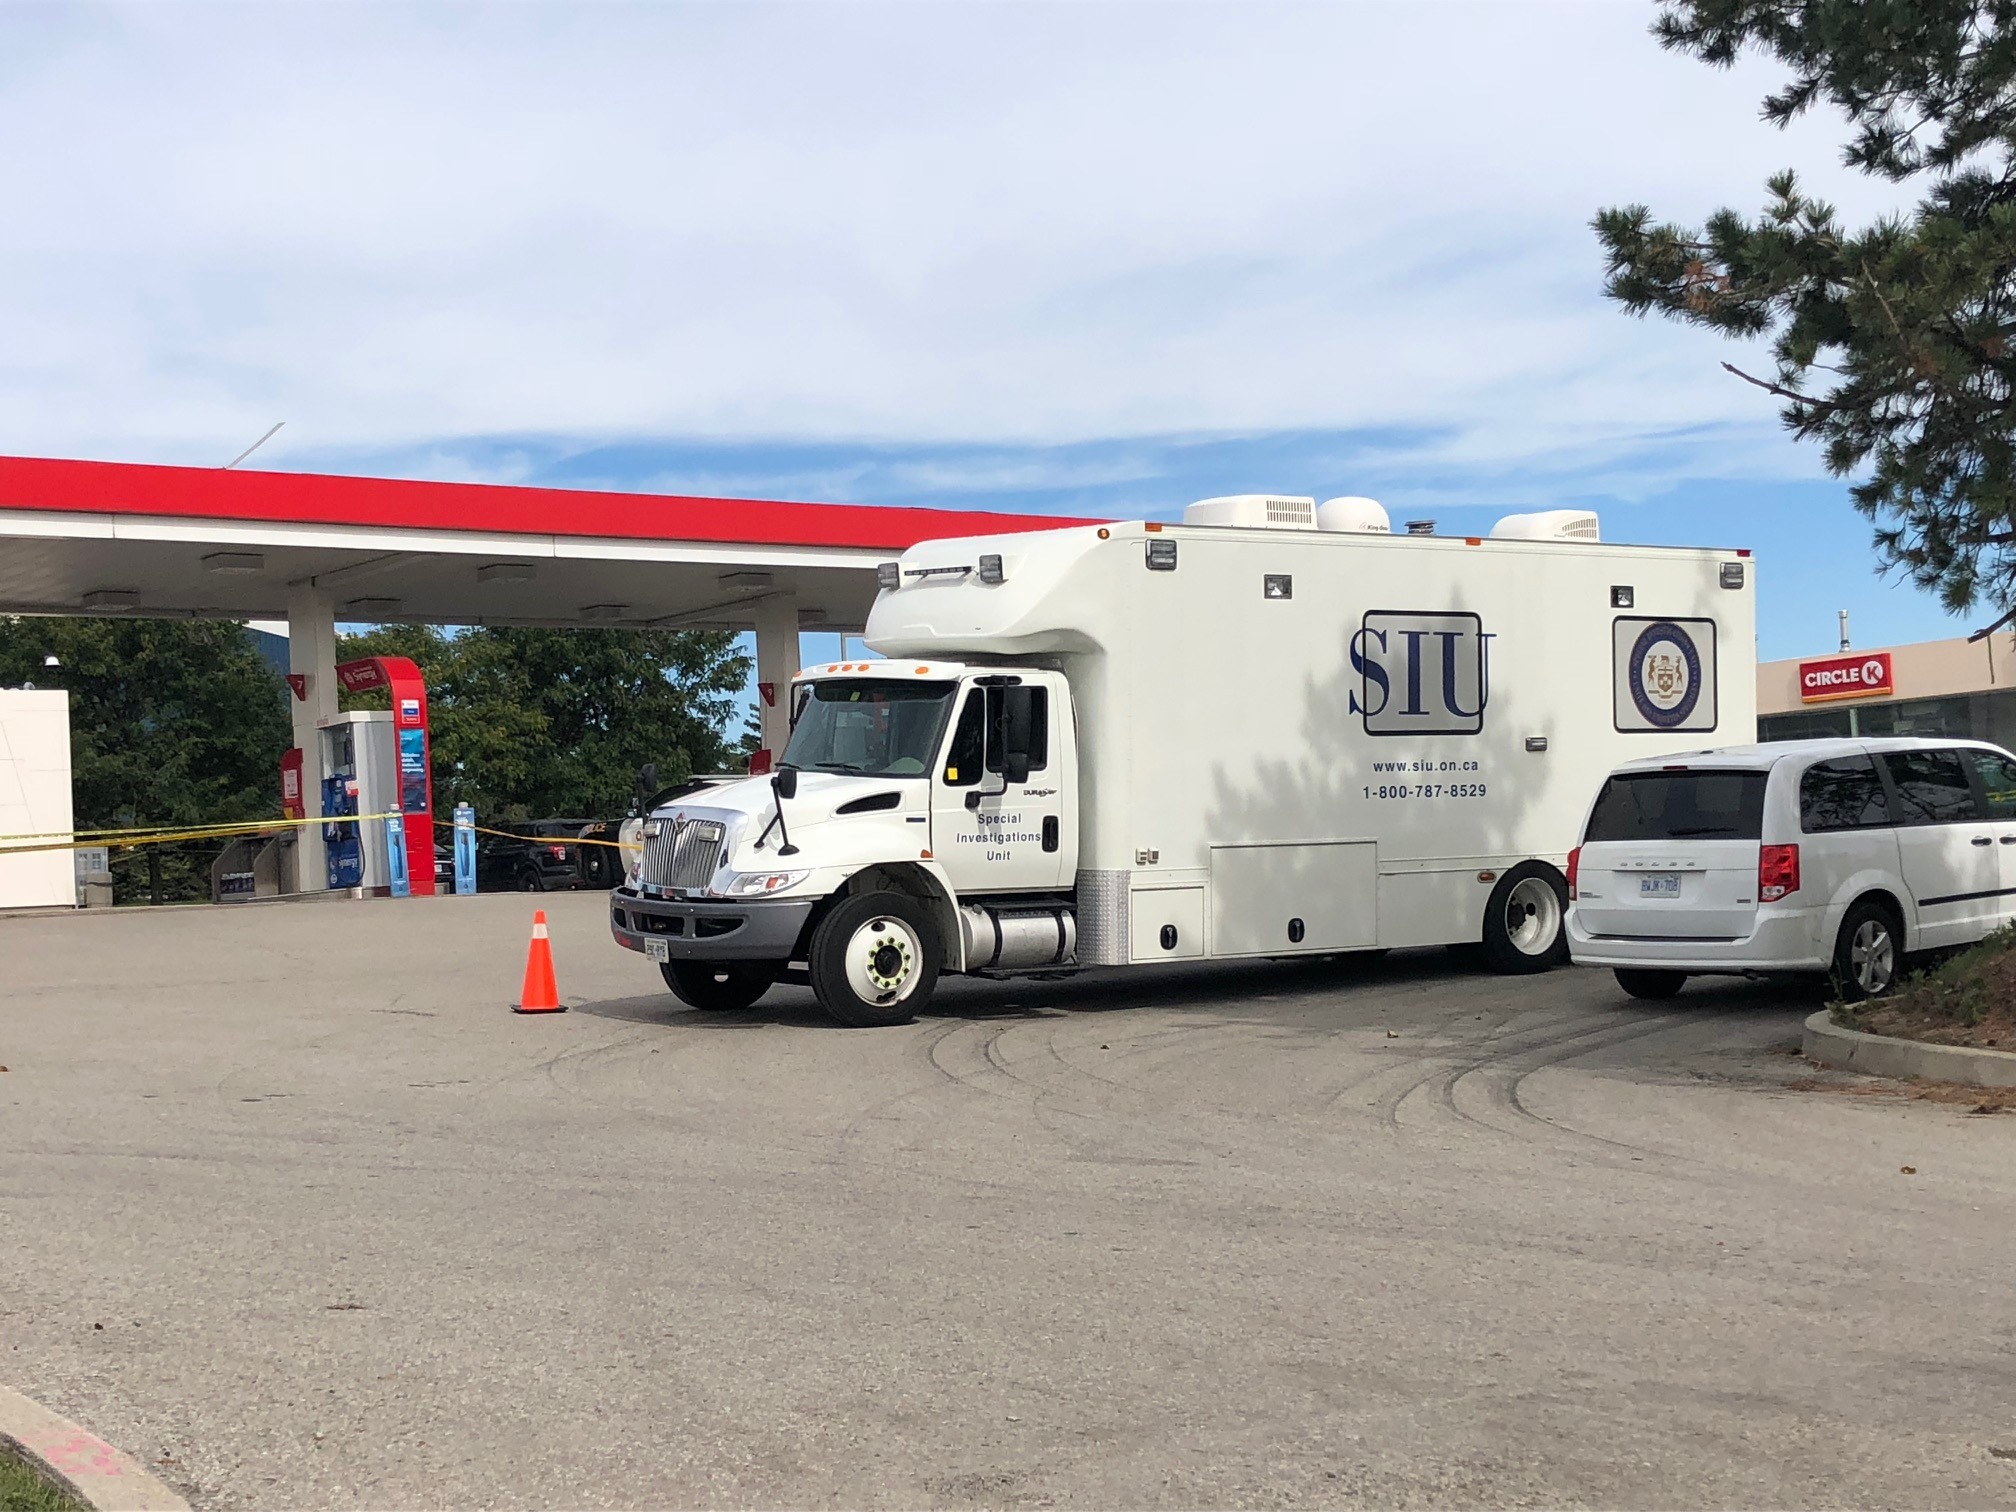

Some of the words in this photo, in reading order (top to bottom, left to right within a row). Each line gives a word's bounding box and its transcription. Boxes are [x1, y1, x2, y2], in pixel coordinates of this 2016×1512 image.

[1349, 627, 1497, 718] SIU
[1804, 667, 1860, 688] CIRCLE
[1866, 665, 1882, 682] K
[297, 680, 303, 690] 7
[767, 688, 773, 697] 9
[1373, 759, 1479, 772] www.siu.on.ca
[1362, 784, 1487, 800] 1-800-787-8529
[978, 813, 1022, 826] Special
[956, 832, 1041, 845] Investigations
[986, 850, 1011, 861] Unit
